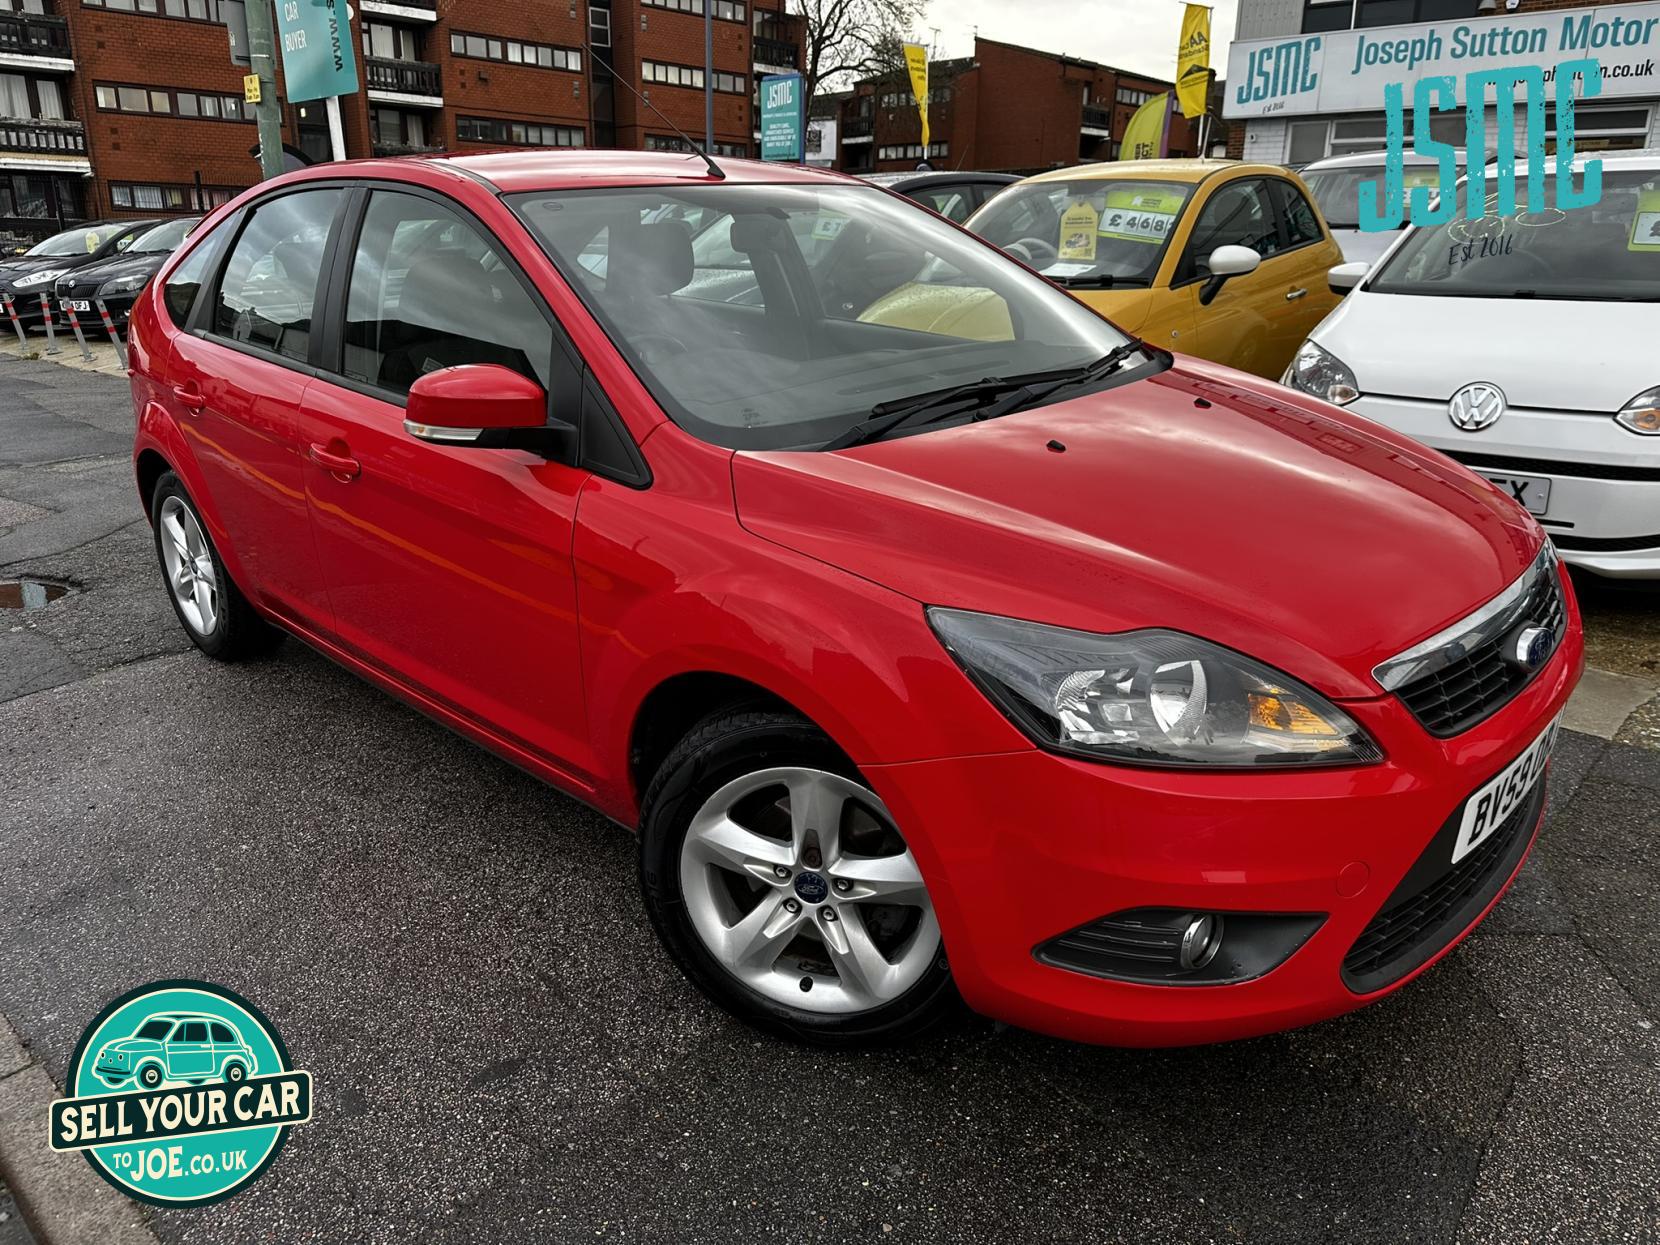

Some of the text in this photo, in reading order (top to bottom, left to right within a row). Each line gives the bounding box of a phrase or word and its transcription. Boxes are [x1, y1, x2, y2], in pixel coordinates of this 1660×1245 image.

[284, 1, 299, 22] CAR
[285, 29, 307, 52] BUYER
[1351, 14, 1659, 75] Joseph Sutton Motor
[1236, 36, 1322, 105] JSMC
[767, 80, 793, 109] JSMC
